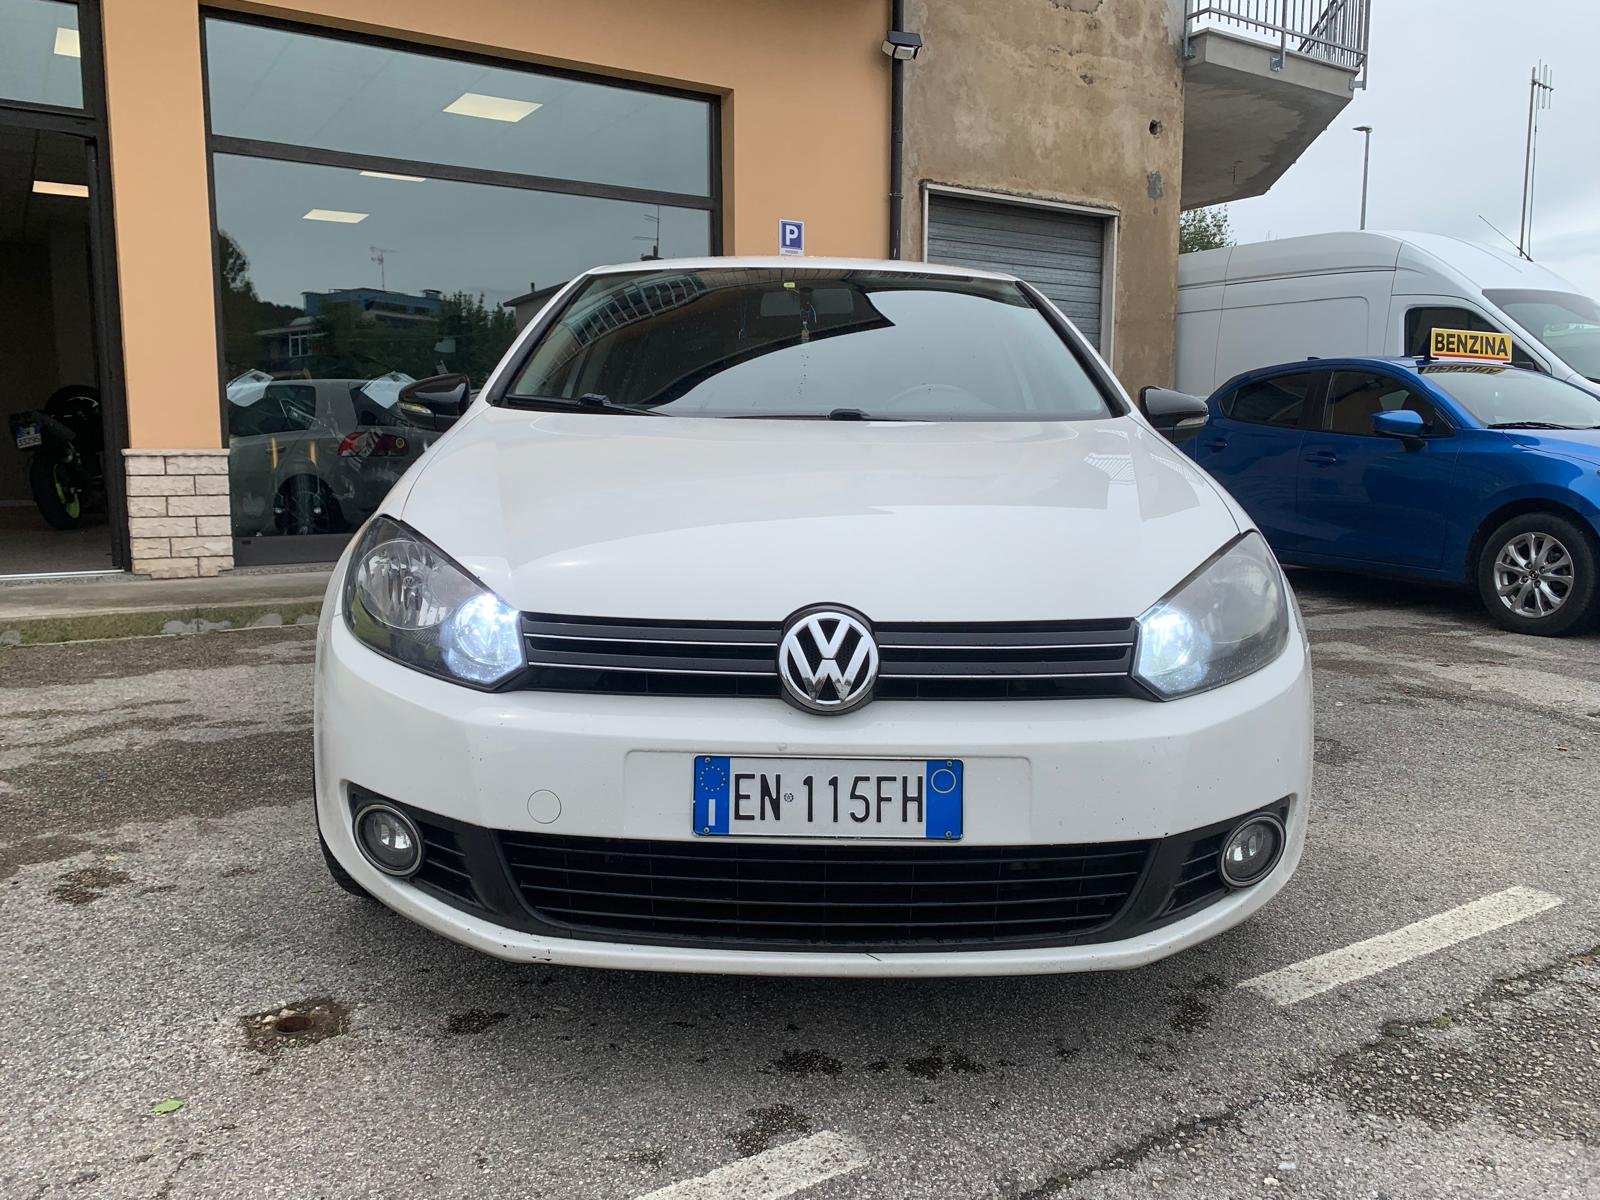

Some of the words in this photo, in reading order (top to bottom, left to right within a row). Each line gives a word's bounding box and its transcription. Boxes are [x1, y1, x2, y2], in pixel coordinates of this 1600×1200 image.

[786, 224, 798, 245] P
[1434, 333, 1508, 356] BENZINA
[734, 774, 781, 821] EN
[803, 776, 923, 823] 115FH
[708, 799, 716, 826] I
